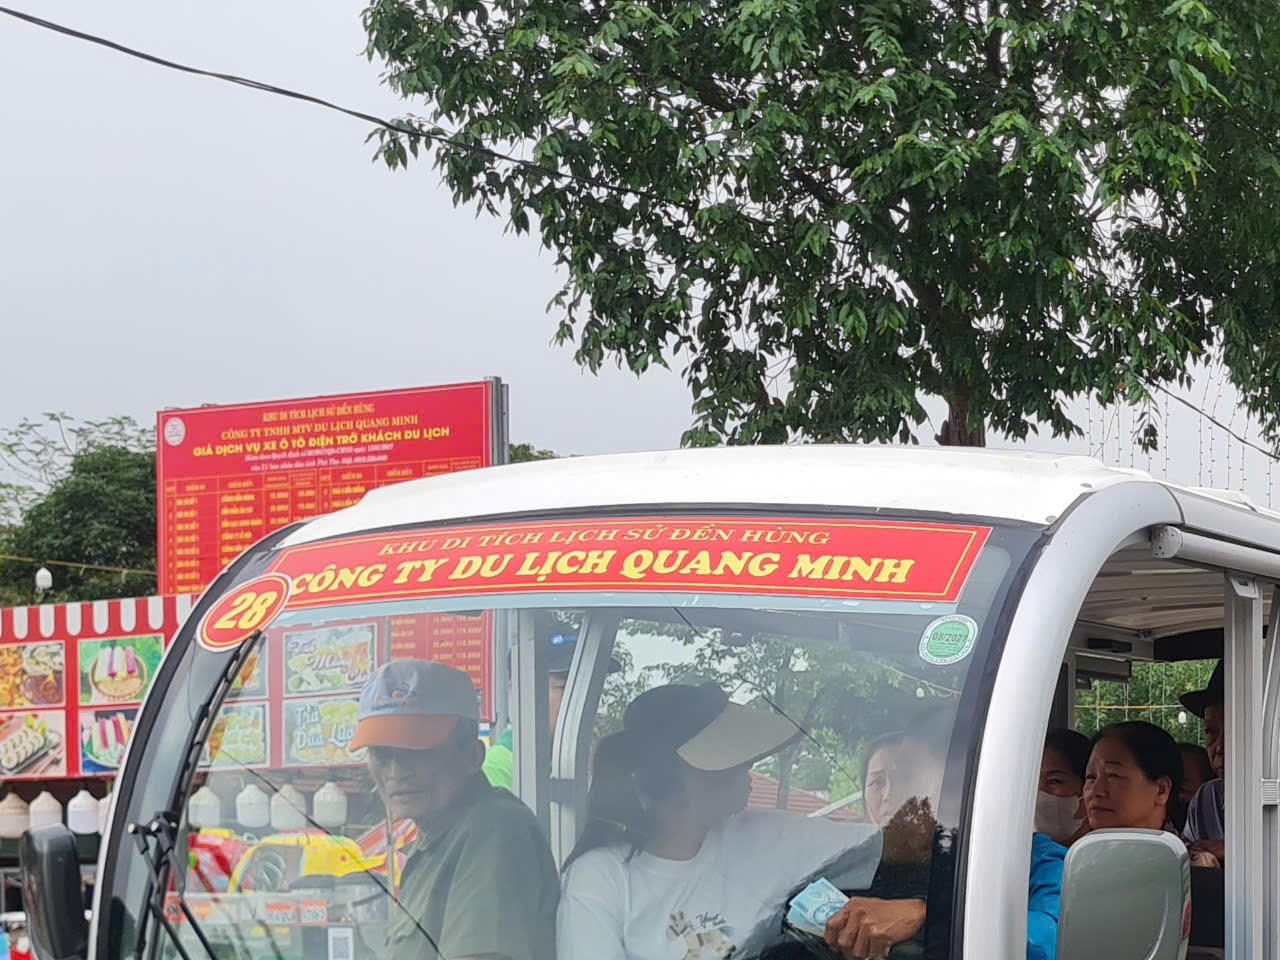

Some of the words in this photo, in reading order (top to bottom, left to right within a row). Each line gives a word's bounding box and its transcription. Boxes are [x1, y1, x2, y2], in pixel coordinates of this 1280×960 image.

[193, 443, 213, 456] GIÁ
[215, 443, 243, 456] DỊCH
[245, 441, 260, 453] VỤ
[263, 440, 277, 451] XE
[308, 434, 334, 447] ĐIỆN
[361, 429, 401, 443] KHÁCH
[404, 429, 420, 439] DU
[423, 426, 450, 440] LỊCH
[222, 429, 248, 440] CÔNG
[250, 428, 262, 438] TY
[263, 426, 290, 436] TNHH
[292, 424, 312, 434] MTV
[314, 422, 329, 432] DU
[356, 417, 389, 430] QUANG
[392, 414, 418, 426] MINH
[377, 541, 438, 556] KHU
[441, 537, 474, 550] DI
[473, 531, 546, 548] TÍCH
[547, 528, 623, 545] LỊCH
[622, 523, 669, 541] SỬ
[670, 523, 736, 541] ĐỀN
[738, 526, 831, 545] HÙNG
[290, 563, 388, 596] CÔNG
[393, 557, 450, 584] TY
[447, 553, 514, 580] DU
[515, 549, 617, 582] LỊCH
[619, 549, 782, 580] QUANG
[788, 553, 916, 584] MINH
[213, 590, 278, 630] 28
